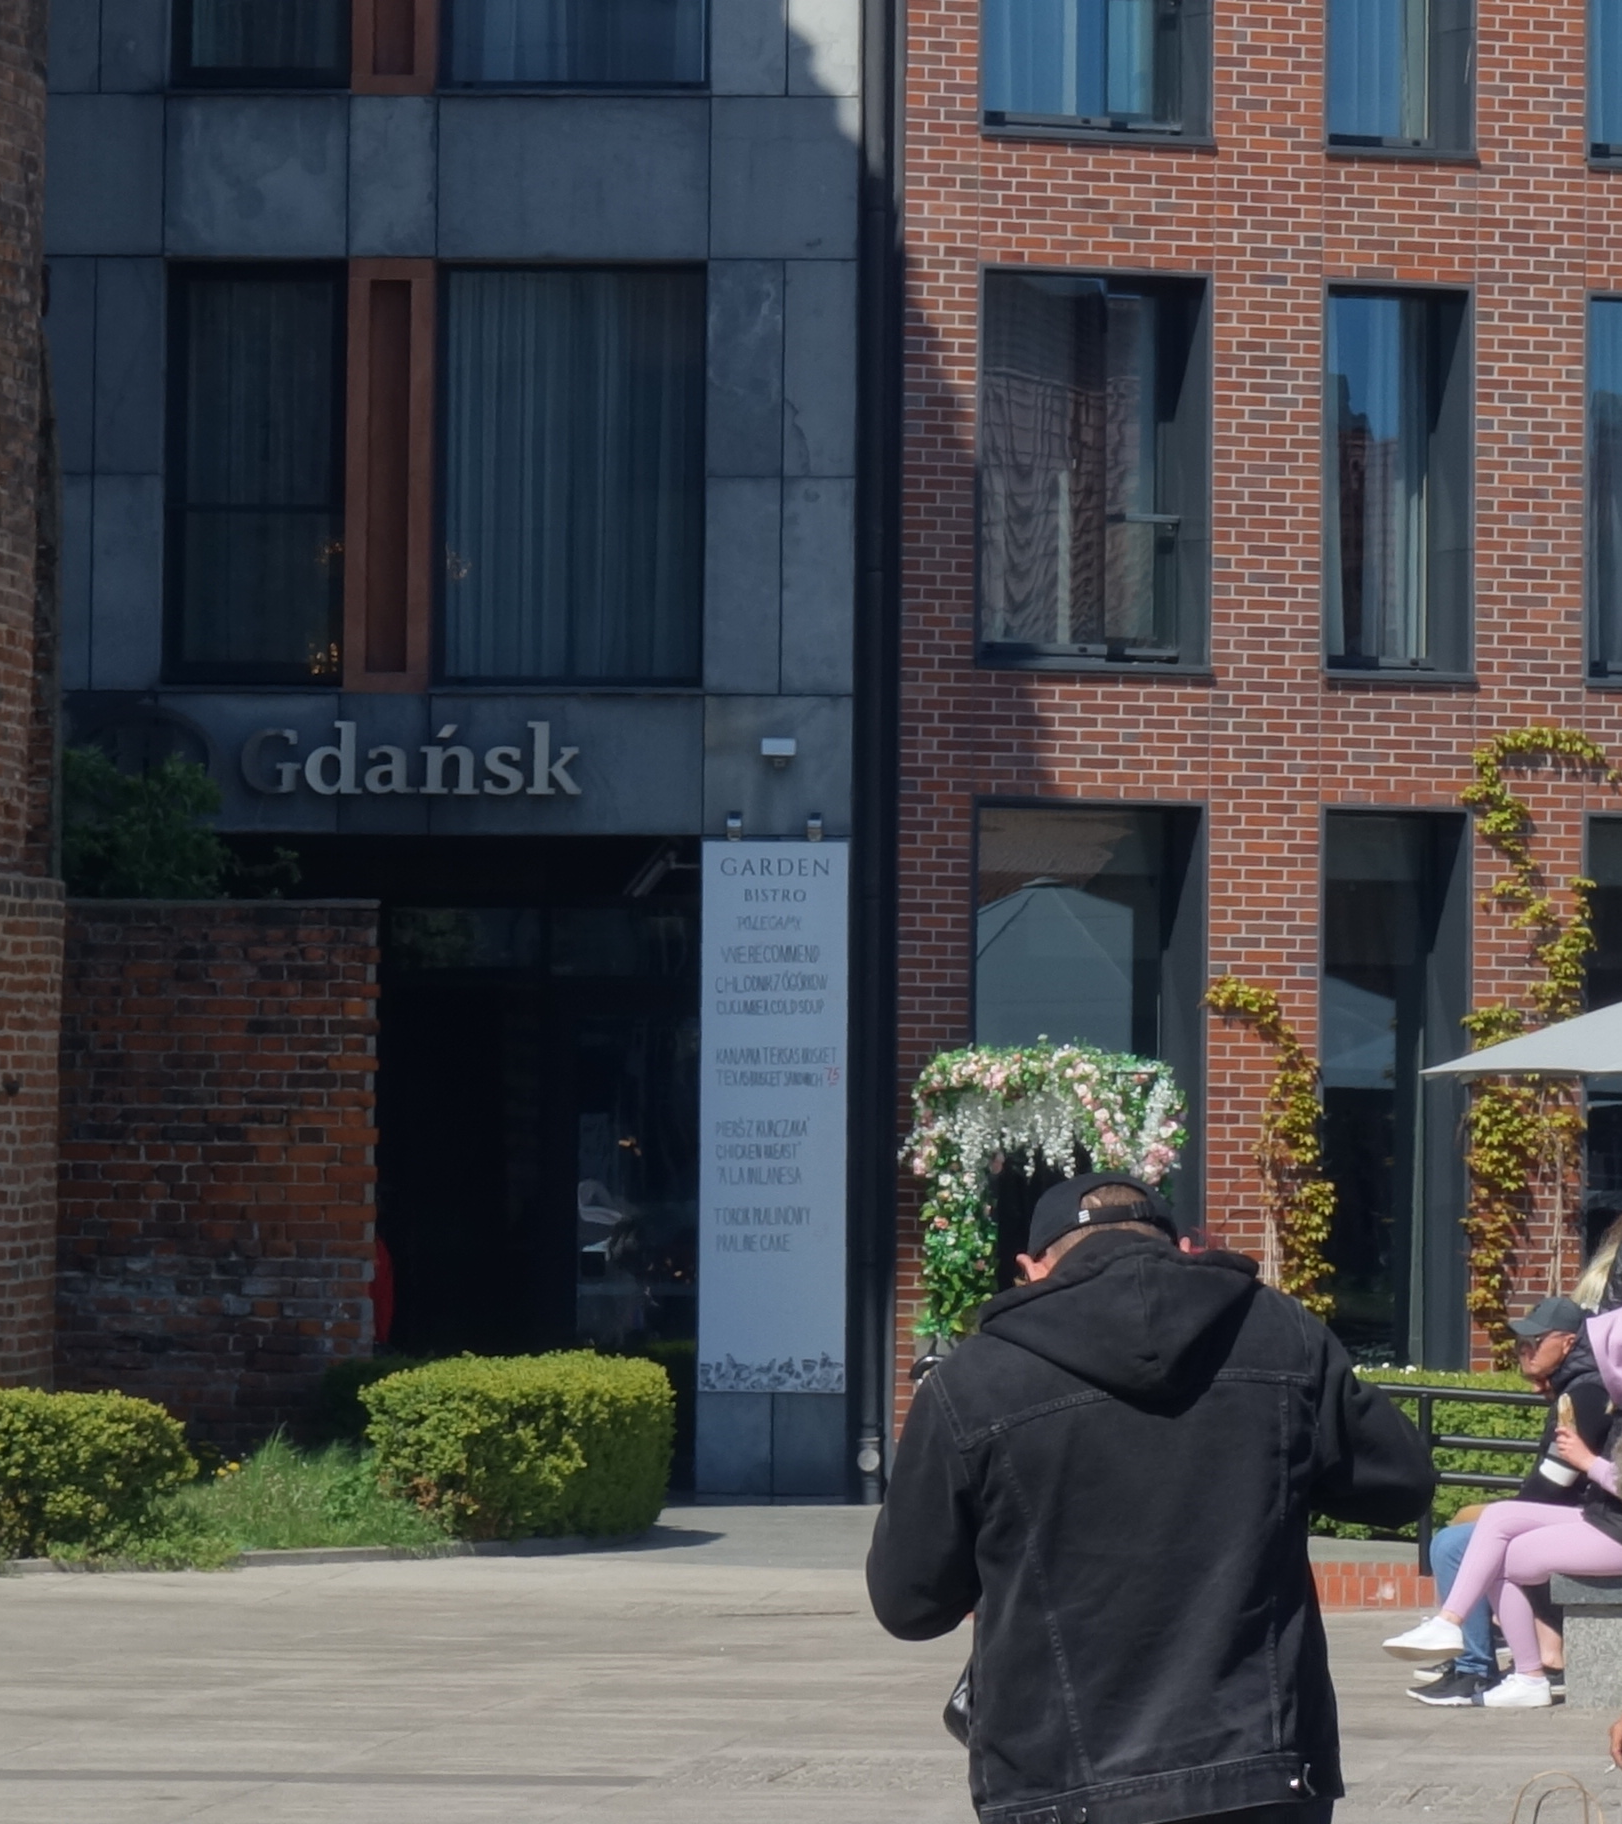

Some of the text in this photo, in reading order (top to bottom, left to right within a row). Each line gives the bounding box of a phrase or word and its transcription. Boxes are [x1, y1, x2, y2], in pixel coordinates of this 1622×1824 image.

[239, 721, 582, 796] Gdańsk
[719, 857, 830, 878] GARDEN
[744, 888, 807, 903] BISTRO
[720, 944, 821, 964] WE RECOMMEND
[824, 1067, 841, 1082] 75
